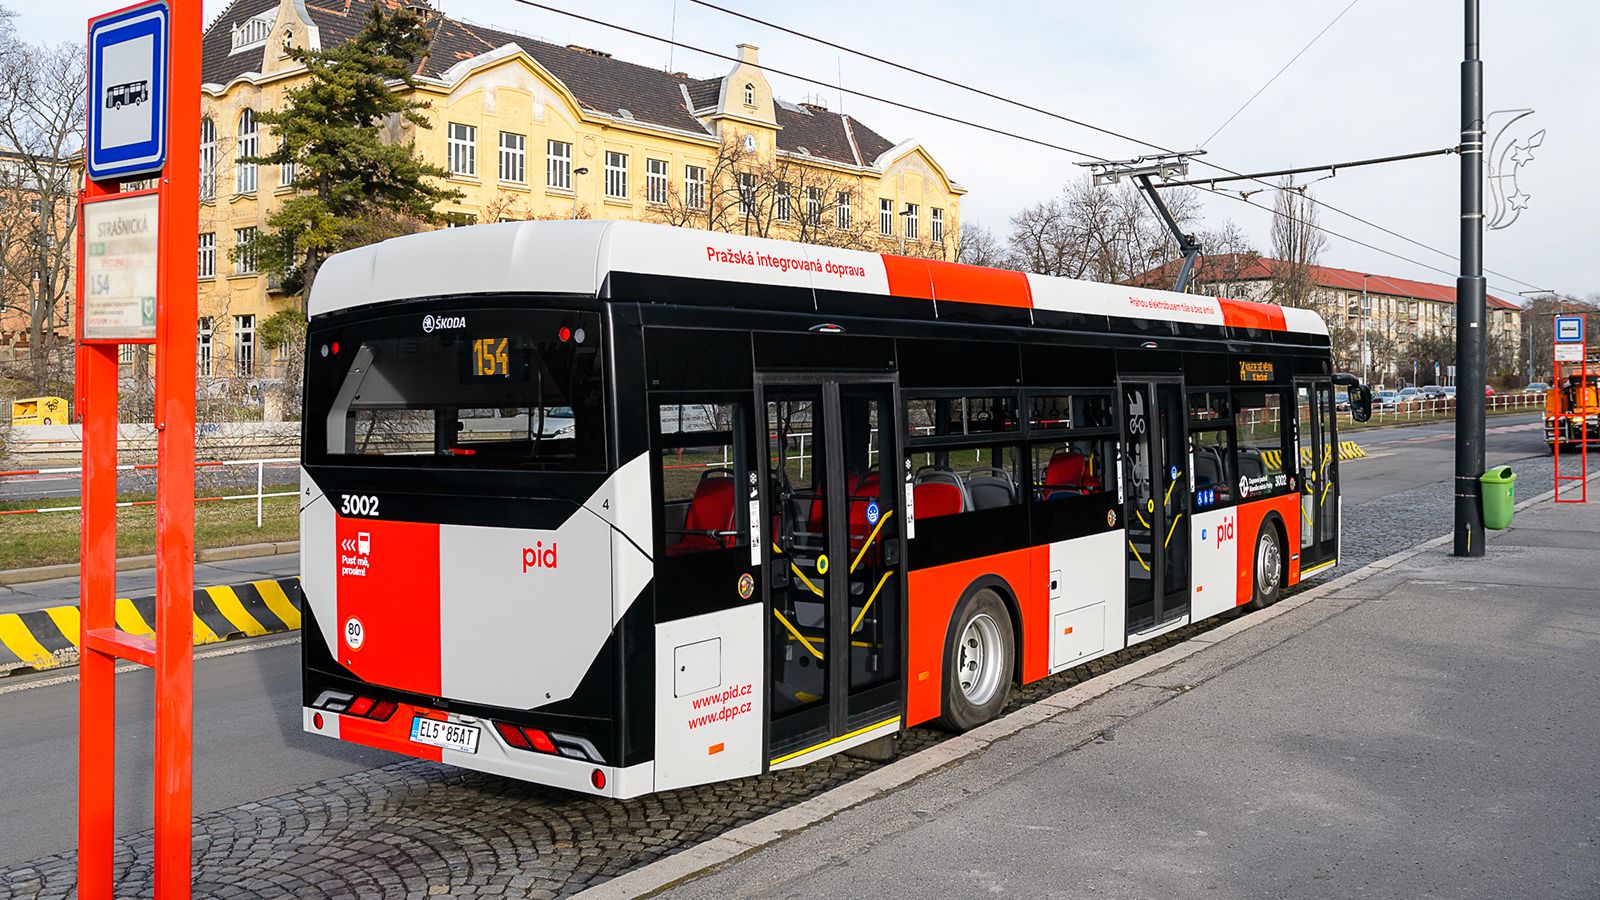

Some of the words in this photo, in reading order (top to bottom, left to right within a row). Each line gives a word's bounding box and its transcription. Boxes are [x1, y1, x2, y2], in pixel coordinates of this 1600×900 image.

[706, 246, 755, 266] Pražská
[756, 251, 823, 273] integrovaná
[825, 260, 865, 278] doprava
[90, 273, 109, 295] 154
[435, 315, 466, 329] ŠKODA
[473, 338, 508, 375] 154
[304, 487, 311, 496] 4
[1275, 474, 1287, 487] 3002
[341, 494, 380, 516] 3002
[602, 499, 610, 510] 4
[1217, 516, 1234, 549] pid
[522, 540, 557, 573] pid
[348, 622, 361, 637] 80
[692, 684, 752, 710] www.pid.cz
[688, 702, 752, 730] www.dpp.cz
[420, 720, 440, 739] EL5
[446, 725, 473, 746] 85AT
